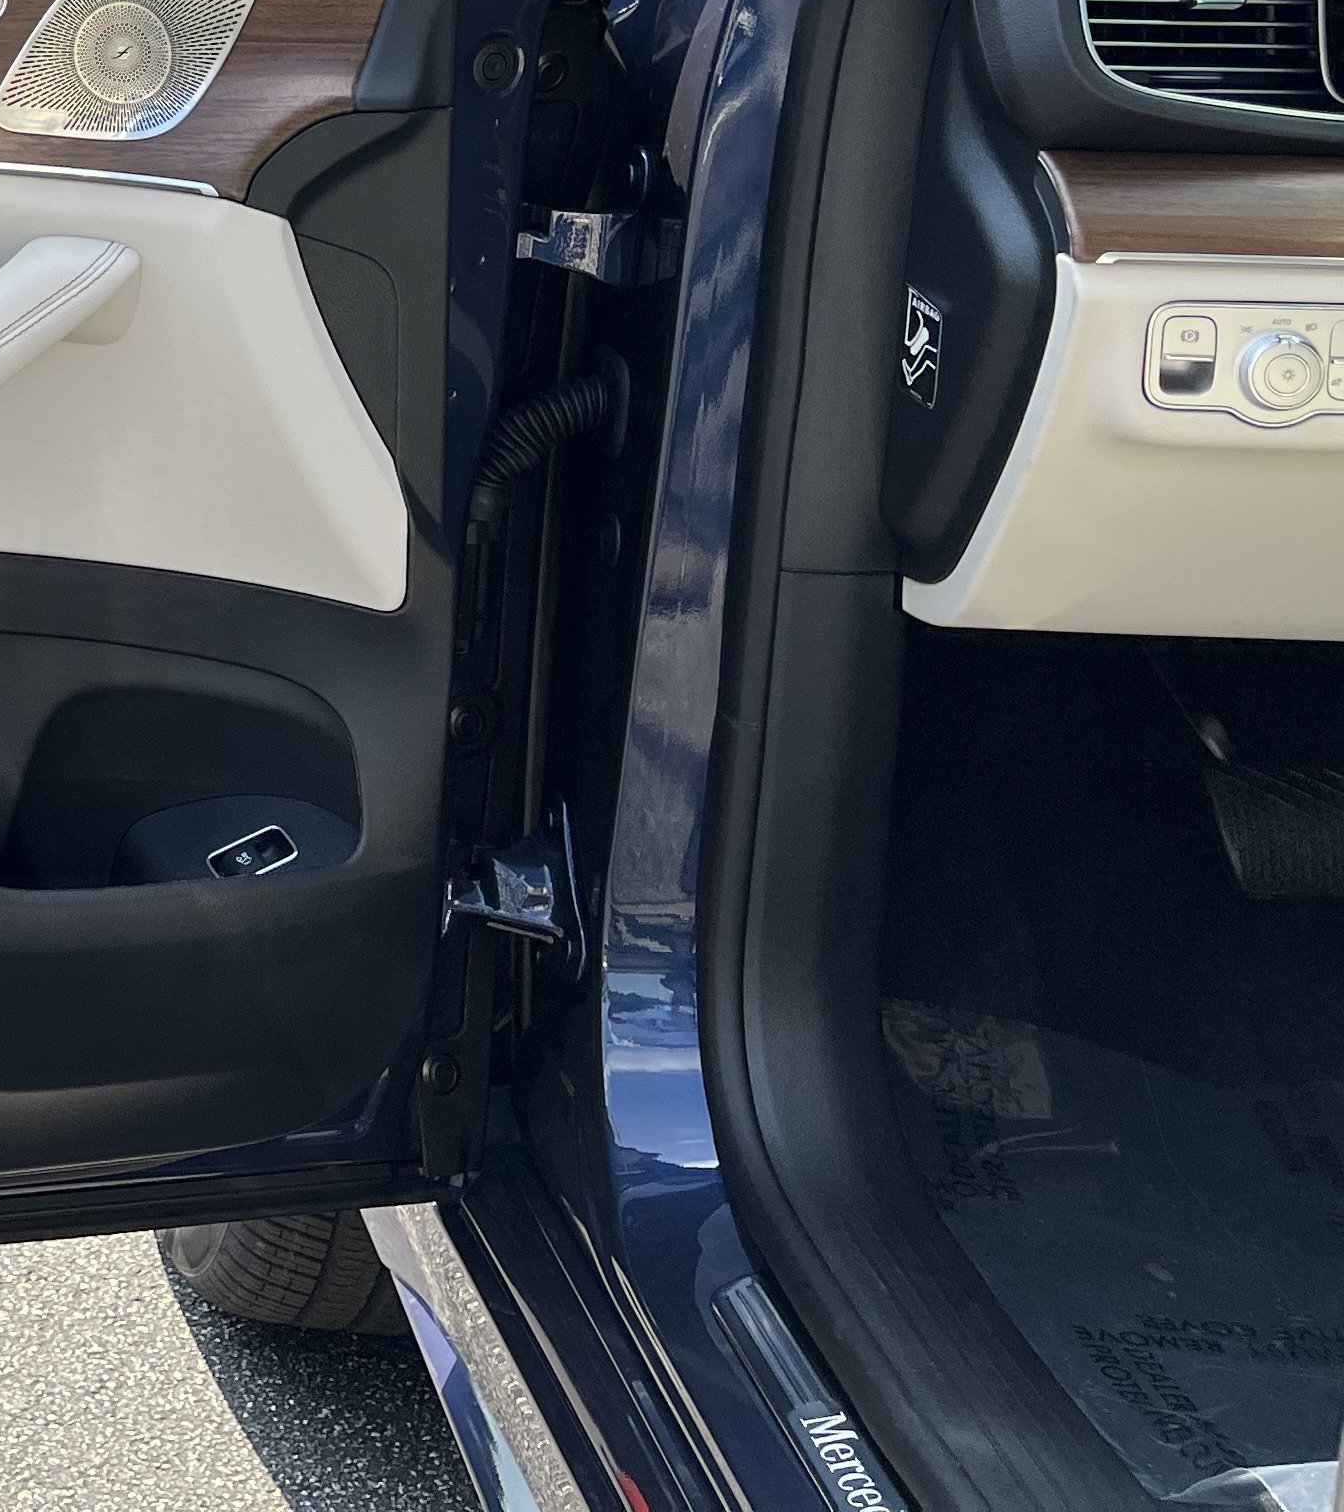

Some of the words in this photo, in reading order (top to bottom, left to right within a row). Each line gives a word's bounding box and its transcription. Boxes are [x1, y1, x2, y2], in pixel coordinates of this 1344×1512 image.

[912, 296, 941, 322] AIRBAG
[1272, 318, 1293, 326] AUTO
[799, 1410, 892, 1512] Merce
